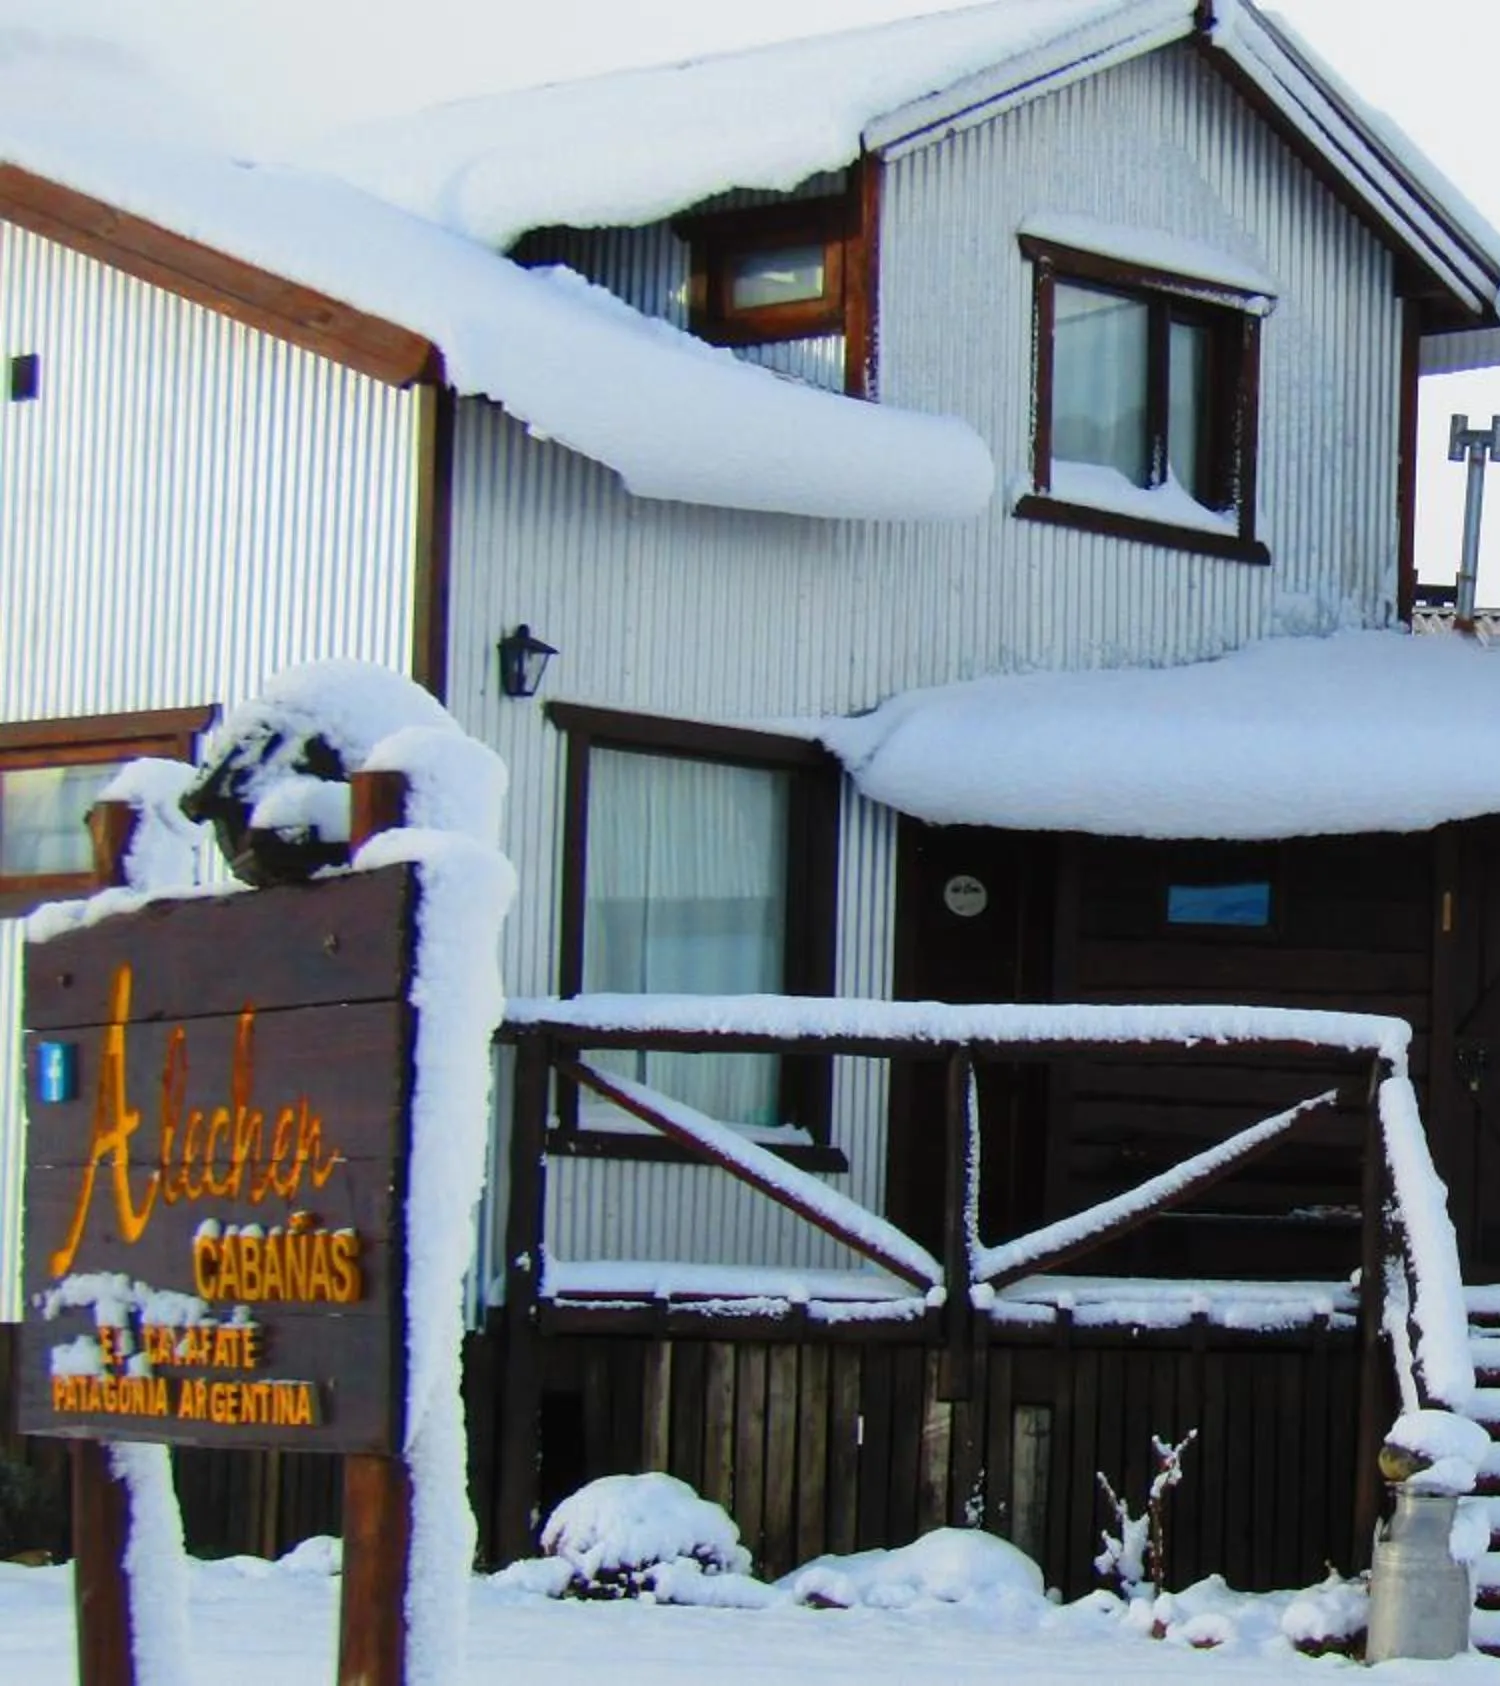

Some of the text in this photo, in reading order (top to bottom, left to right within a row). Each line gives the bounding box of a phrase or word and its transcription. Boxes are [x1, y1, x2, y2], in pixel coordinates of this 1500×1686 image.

[193, 1211, 360, 1304] CABAÑAS
[53, 1374, 313, 1426] PATAGONIA ARGENTINA
